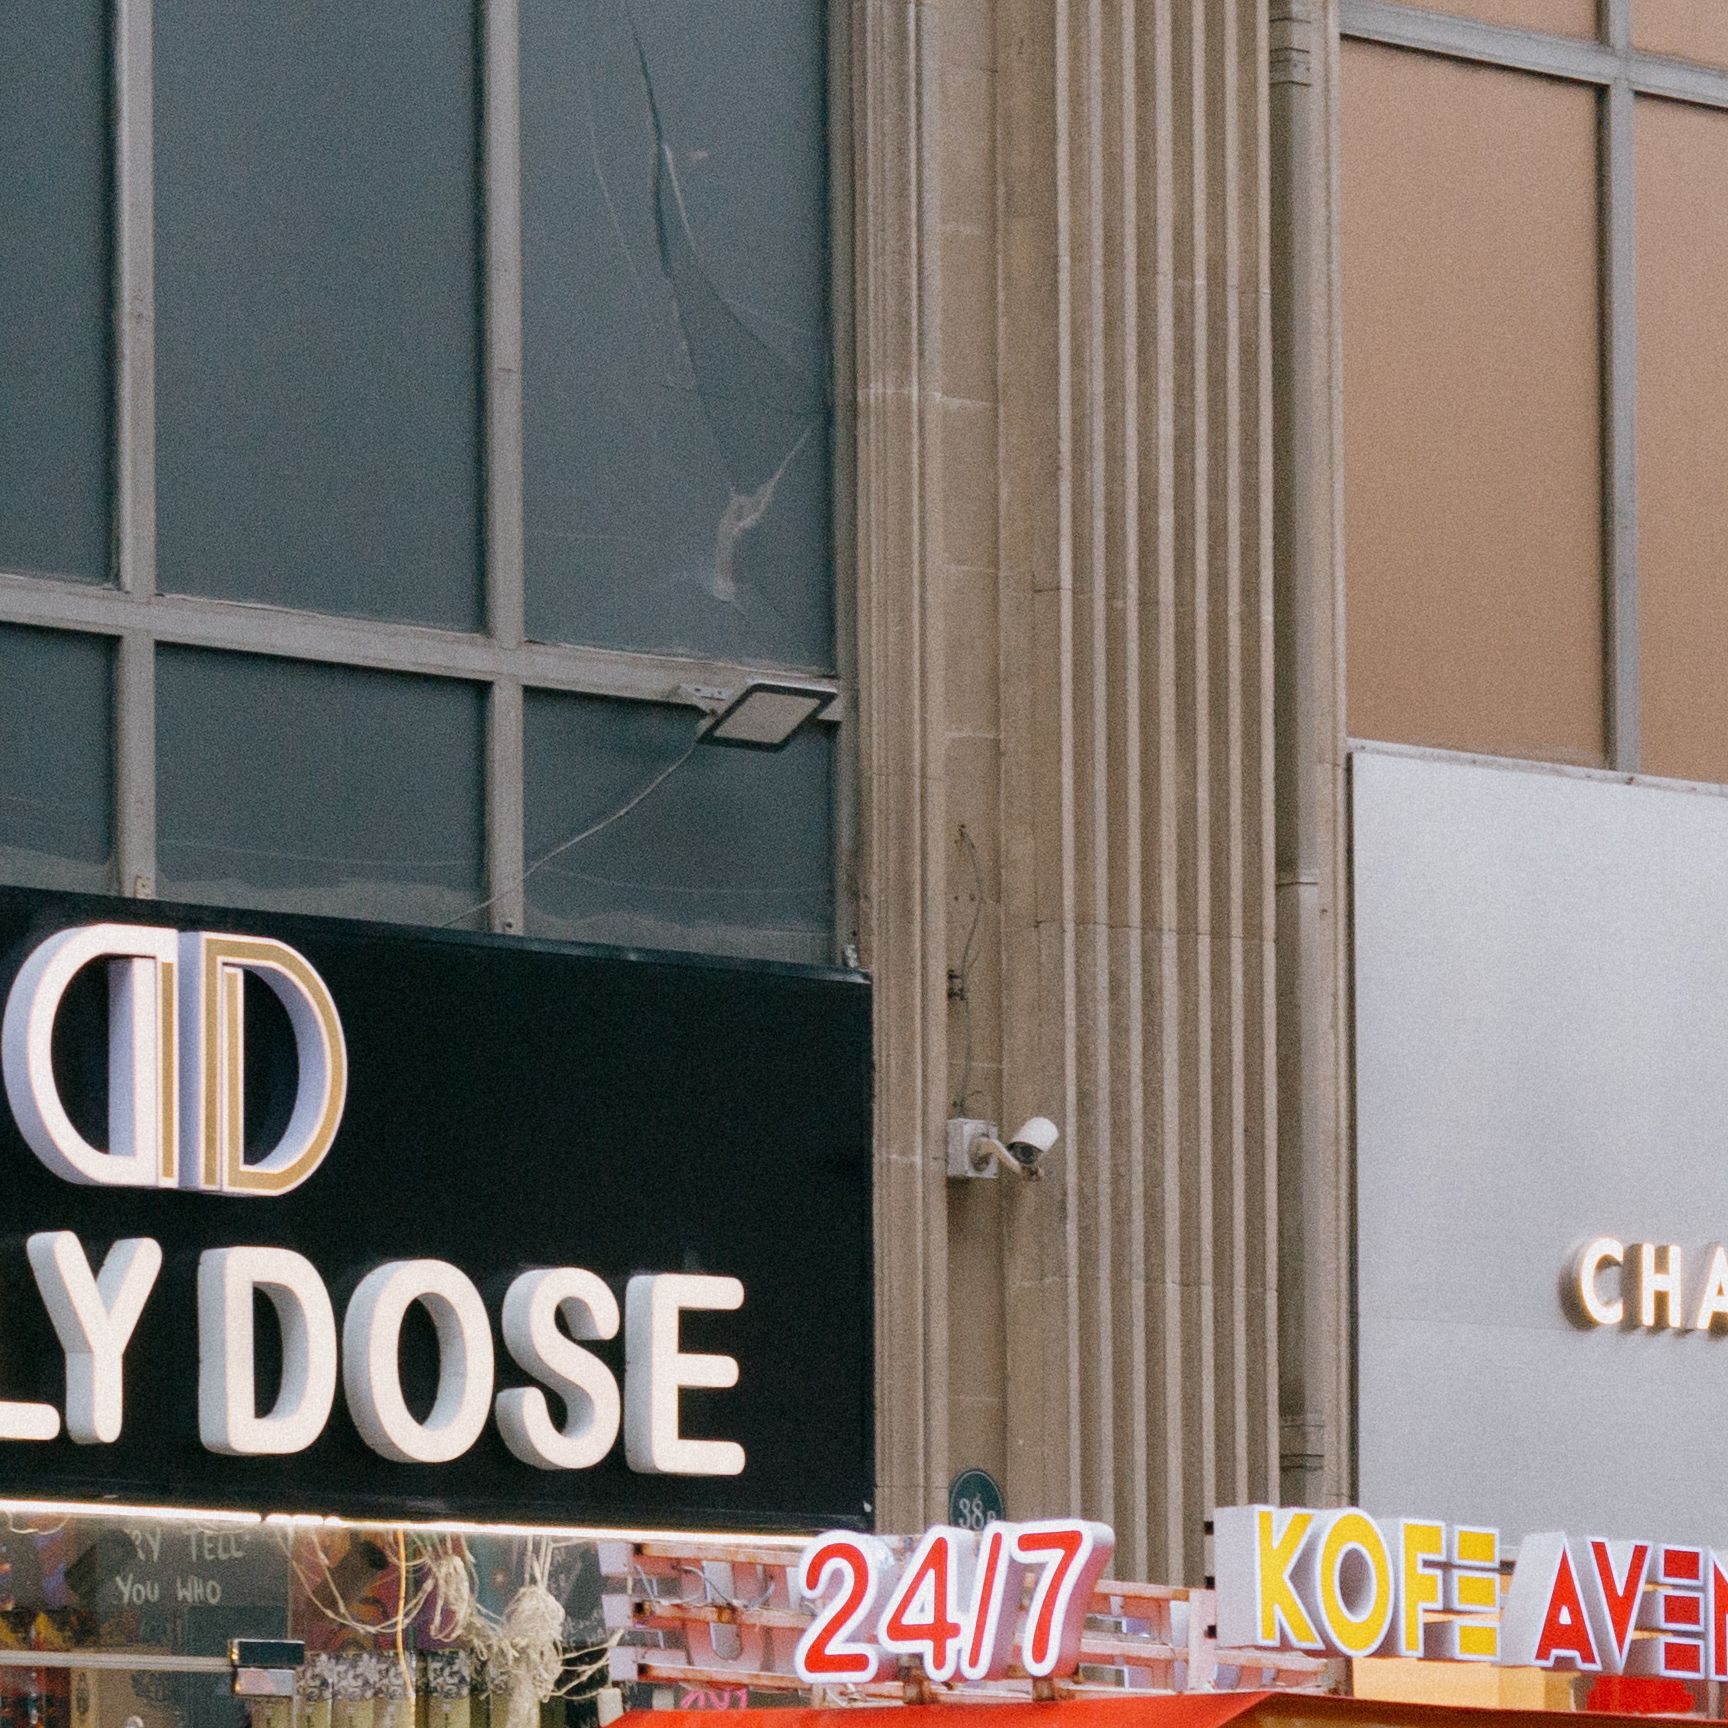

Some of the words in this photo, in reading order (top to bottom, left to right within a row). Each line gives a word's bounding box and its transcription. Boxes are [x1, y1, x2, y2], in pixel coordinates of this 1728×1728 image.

[197, 1244, 747, 1477] DOSE
[794, 1518, 1115, 1684] 24/7
[1222, 1504, 1502, 1662] KOFE
